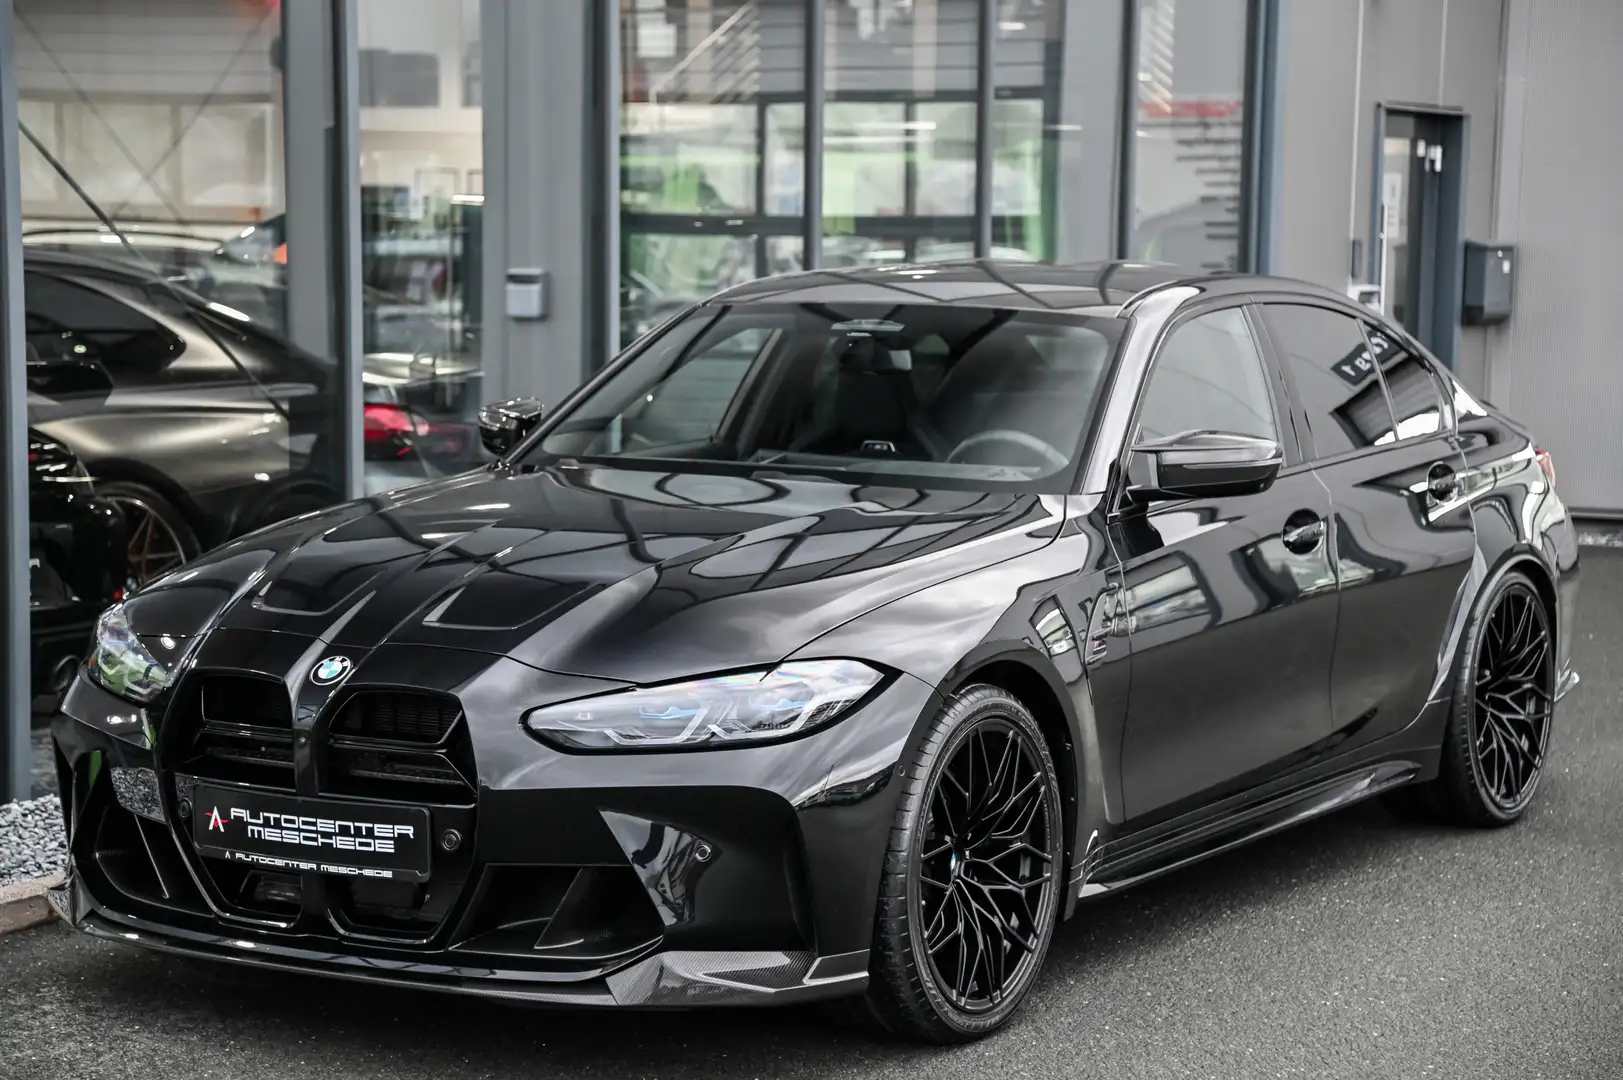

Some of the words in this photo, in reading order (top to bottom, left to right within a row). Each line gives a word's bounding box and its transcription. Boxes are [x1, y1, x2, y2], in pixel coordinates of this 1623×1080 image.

[230, 807, 414, 839] AUTOCENTER
[247, 825, 395, 853] MESCHEDE
[235, 852, 317, 871] AUTOCENTER
[320, 864, 393, 878] MESCHEDE
